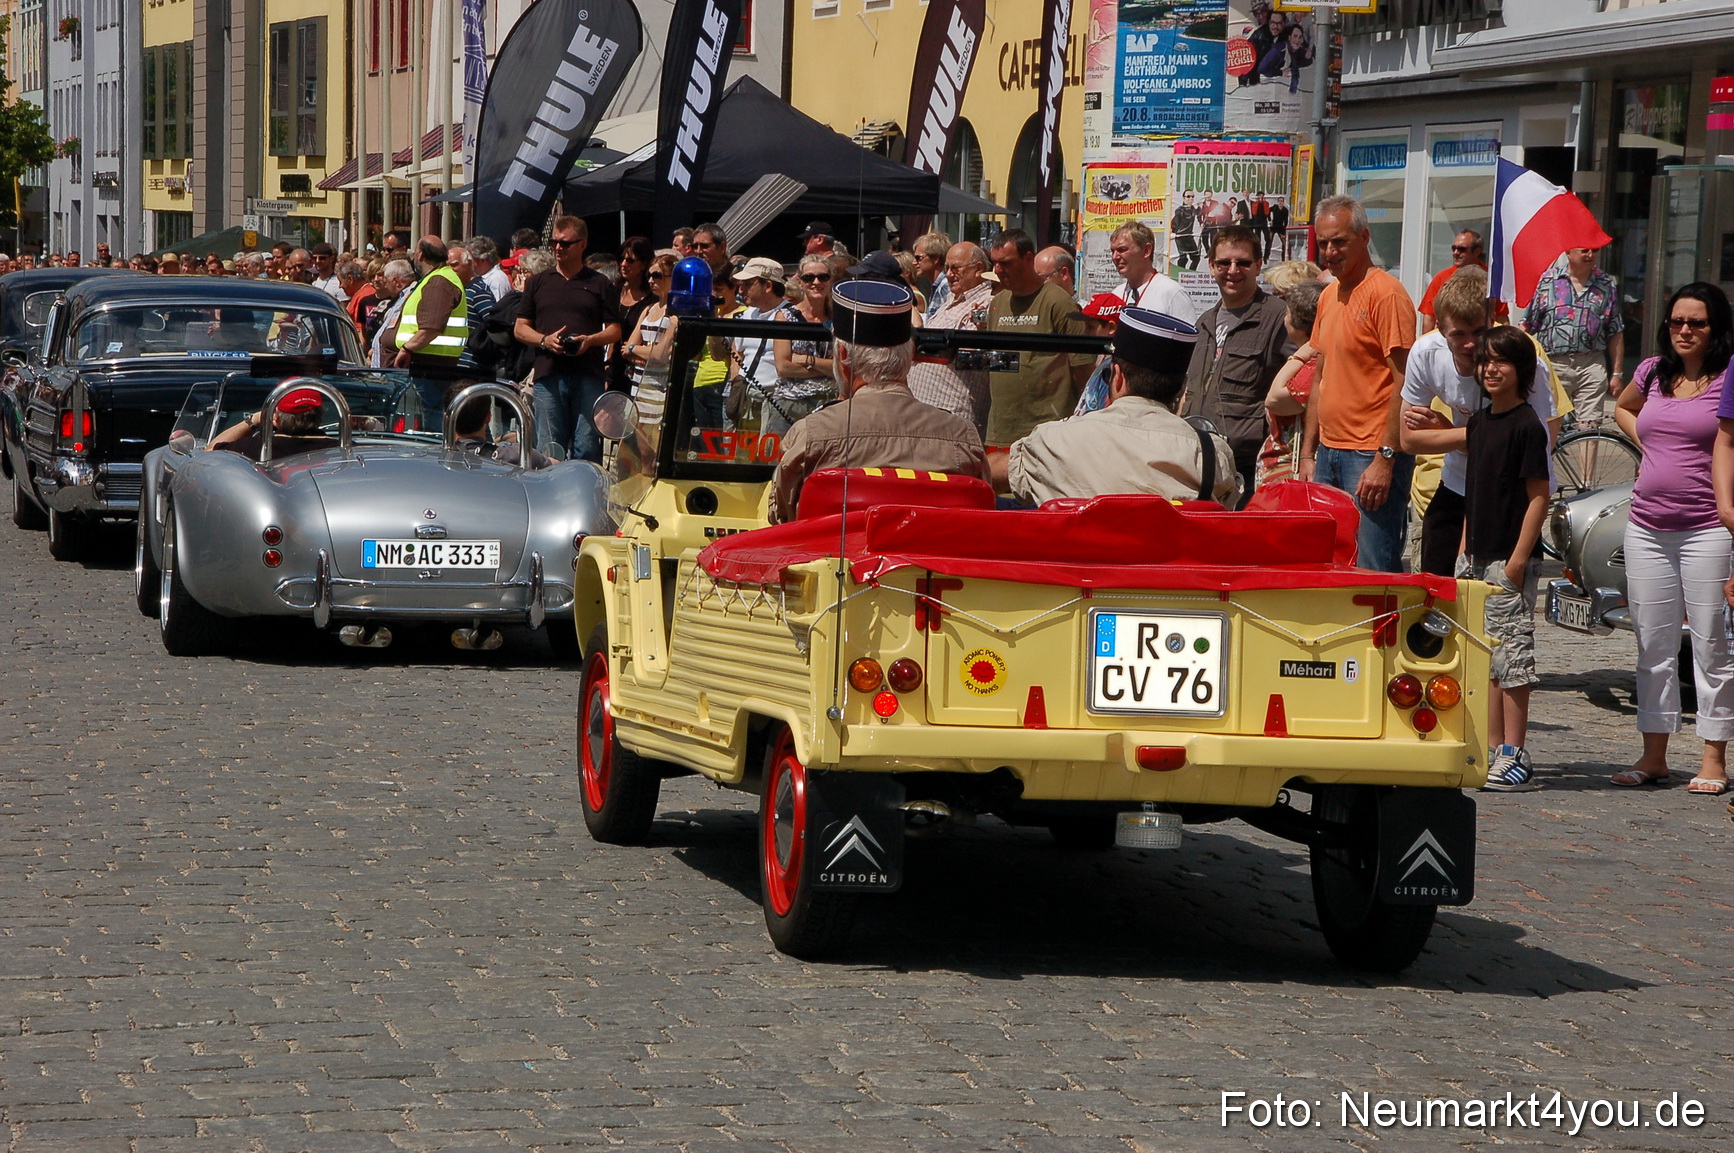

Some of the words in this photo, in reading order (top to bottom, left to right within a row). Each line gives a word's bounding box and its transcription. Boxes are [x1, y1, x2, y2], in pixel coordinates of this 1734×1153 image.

[711, 20, 726, 66] SWEDEN
[587, 45, 613, 88] SWEDEN
[957, 36, 973, 81] SWEDEN
[1124, 55, 1166, 66] MANFRED
[1168, 54, 1209, 65] MANN'S
[1124, 65, 1177, 76] EARTHBAND
[1123, 79, 1168, 90] WOLFGANG
[1170, 78, 1212, 89] AMBROS
[667, 0, 729, 192] THULE
[498, 23, 620, 202] THULE
[1122, 107, 1152, 122] 20.8.
[1153, 113, 1210, 121] BROMBACHSEE
[1352, 146, 1378, 169] BRILLEN
[1378, 145, 1406, 168] WEBER
[1435, 142, 1466, 165] BRILLEN
[1466, 141, 1496, 164] WEBER
[1176, 162, 1182, 192] I
[1185, 162, 1228, 193] DOLCI
[1231, 162, 1288, 195] SIGNORI
[256, 201, 294, 210] Klostergasse
[1109, 198, 1164, 216] Oldtimertreffen
[376, 544, 402, 565] NM
[418, 544, 443, 565] AC
[449, 544, 485, 566] 333
[1101, 641, 1110, 652] D
[1137, 622, 1160, 660] R
[963, 649, 985, 666] ATOMIC
[985, 649, 1006, 672] POWER?
[1284, 662, 1333, 677] Méhari
[964, 680, 974, 690] NO
[974, 683, 999, 695] THANKS
[1102, 664, 1151, 702] CV
[1167, 667, 1213, 704] 76
[820, 871, 888, 884] CITROËN
[1393, 885, 1459, 897] CITROËN
